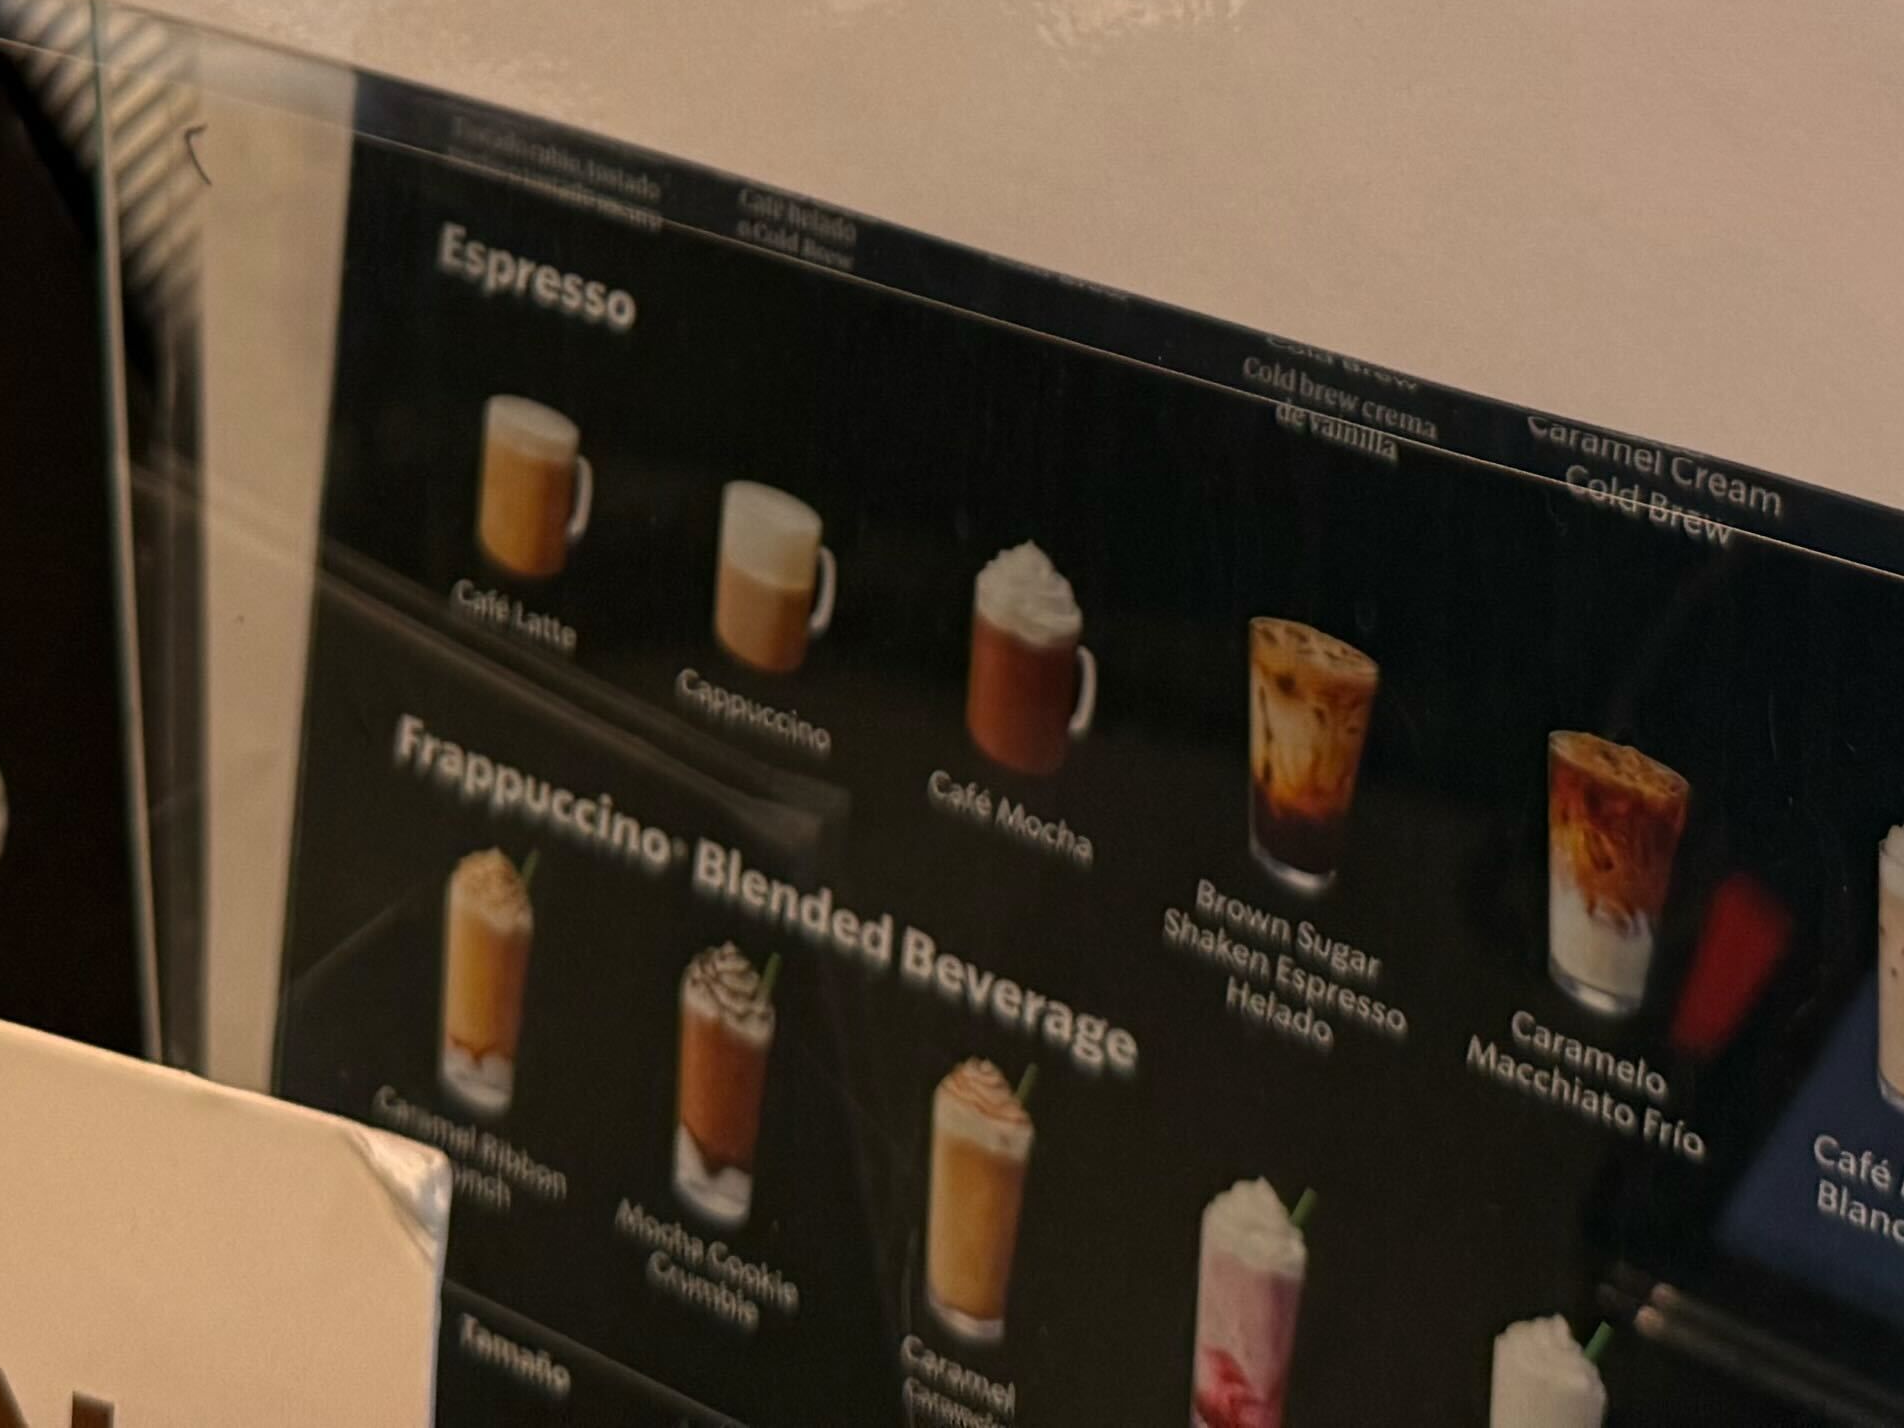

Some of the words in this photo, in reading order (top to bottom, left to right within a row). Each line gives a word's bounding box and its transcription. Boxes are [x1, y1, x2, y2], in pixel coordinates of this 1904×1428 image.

[438, 221, 637, 330] Espresso
[753, 221, 799, 256] Cold
[1243, 356, 1295, 393] Cold
[1299, 372, 1360, 413] brew
[1362, 400, 1439, 443] crema
[1275, 397, 1306, 428] de
[1308, 409, 1399, 463] vainilla
[1527, 415, 1663, 476] Caramel
[1670, 456, 1783, 518] Cream
[1566, 464, 1639, 514] Cold
[1649, 491, 1733, 546] Brew
[452, 578, 510, 624] Café
[513, 600, 577, 651] Latte
[675, 668, 831, 757] Cappuccino
[928, 770, 992, 818] Café
[996, 797, 1094, 866] Mocha
[694, 838, 894, 966] Blended
[900, 926, 1139, 1068] Beverage
[1164, 908, 1271, 976] Shaken
[1276, 955, 1408, 1035] Espresso
[1197, 878, 1292, 944] Brown
[1297, 920, 1383, 980] Sugar
[1226, 976, 1334, 1050] Helado
[1512, 1010, 1668, 1099] Caramelo
[1467, 1034, 1636, 1130] Macchiato
[1814, 1134, 1892, 1191] Café
[706, 1241, 799, 1318] Cookie
[900, 1334, 1016, 1421] Caramel
